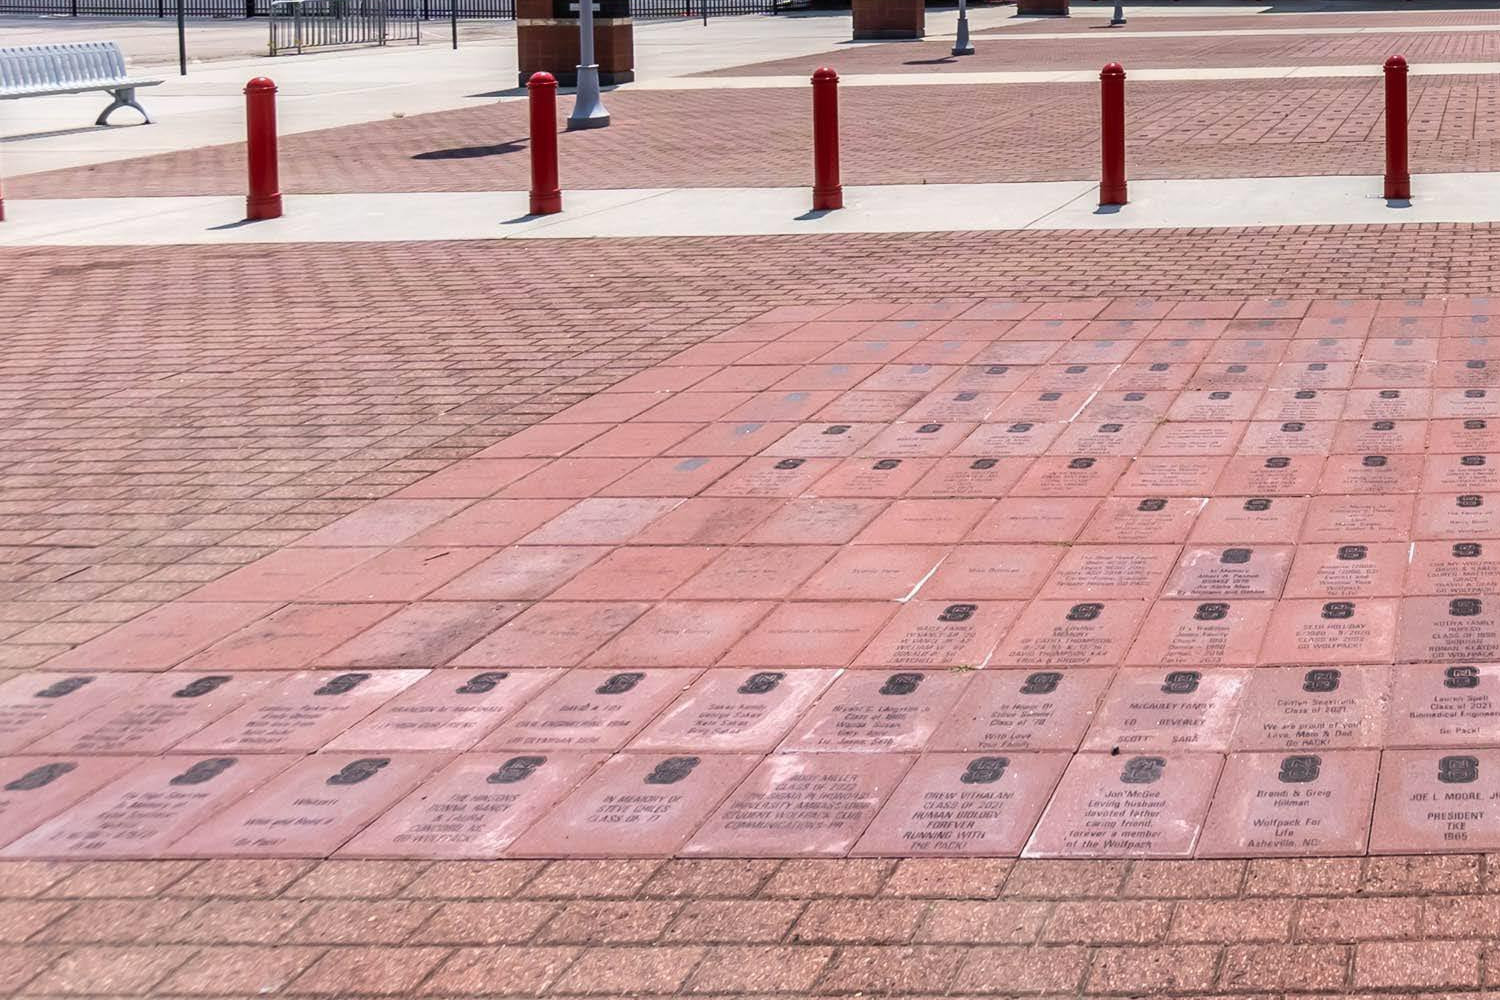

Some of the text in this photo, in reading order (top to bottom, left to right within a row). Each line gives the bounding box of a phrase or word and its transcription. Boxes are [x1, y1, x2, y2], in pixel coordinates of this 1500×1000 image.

[1172, 735, 1199, 743] SARA
[603, 795, 682, 803] IN MEMORY OF
[597, 805, 631, 813] STEVE
[912, 811, 1002, 820] HUMAN BIOLOGY
[1427, 812, 1484, 820] PRESIDENT
[1254, 819, 1301, 828] Wolfpack
[1447, 822, 1466, 830] TKE
[903, 831, 953, 839] RUNNING
[911, 842, 931, 850] THE
[1103, 840, 1152, 849] Wolfpack
